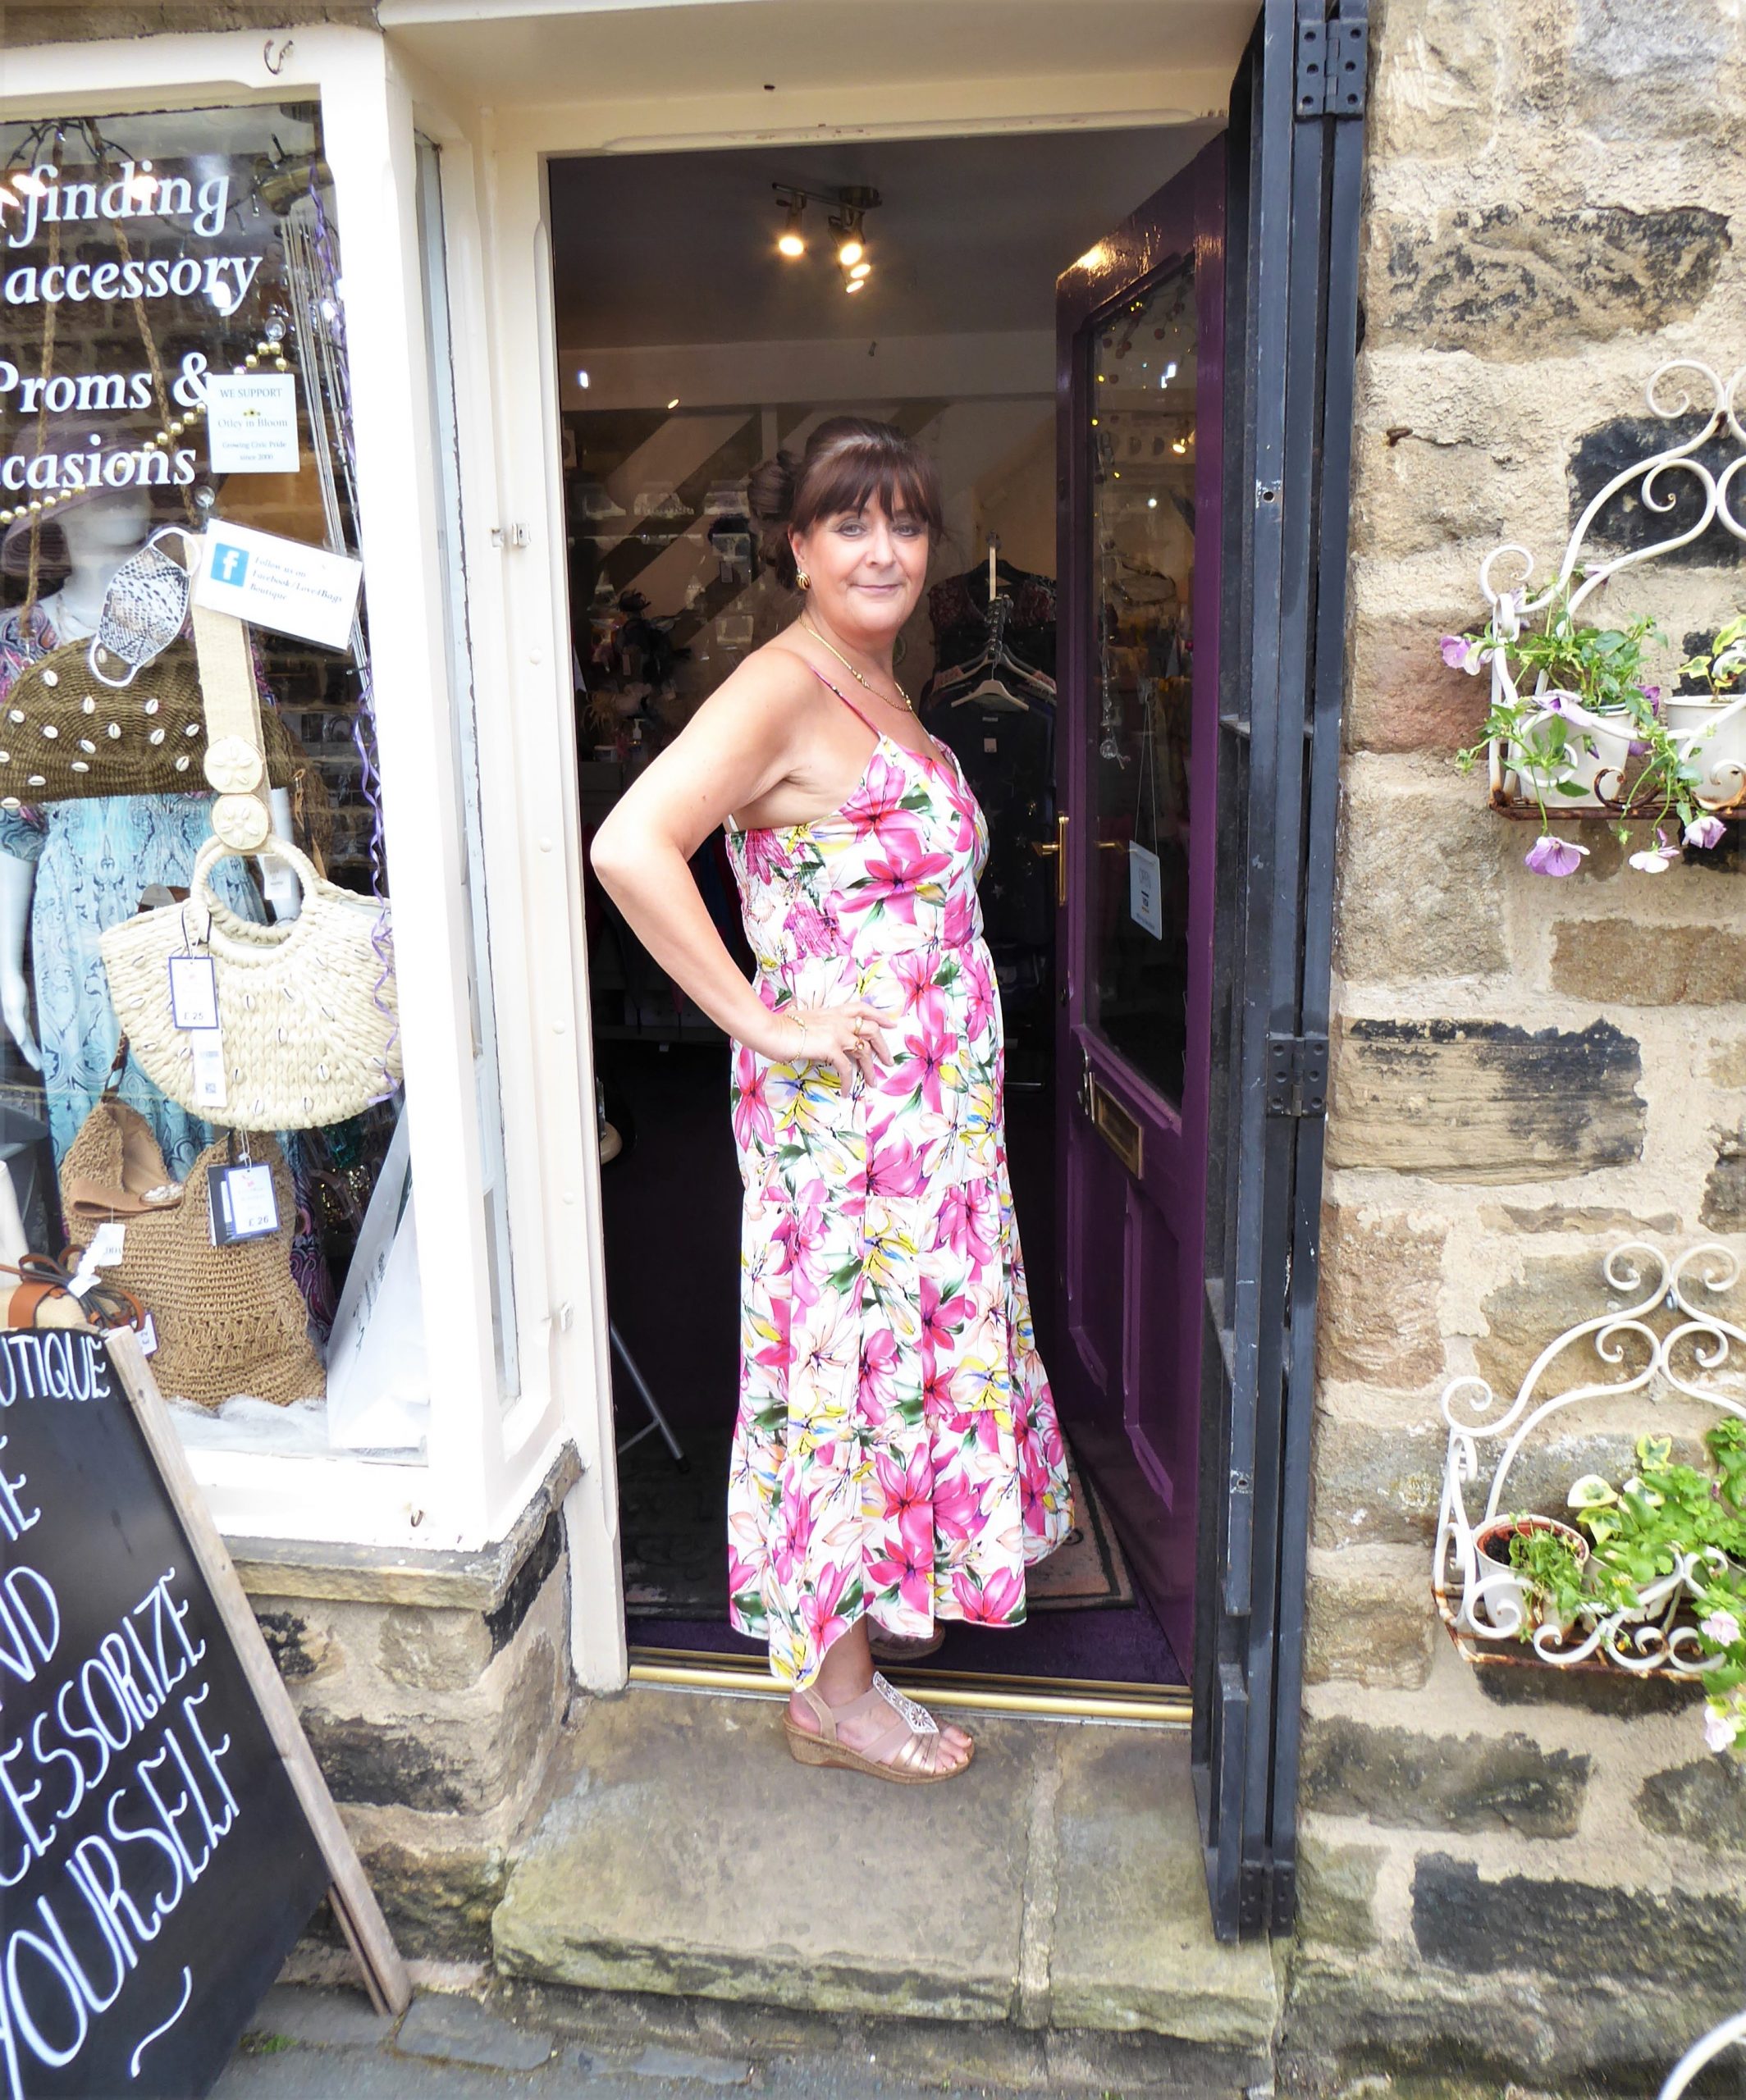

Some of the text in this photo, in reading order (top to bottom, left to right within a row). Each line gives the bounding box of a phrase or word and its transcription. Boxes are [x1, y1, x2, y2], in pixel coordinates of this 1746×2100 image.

[8, 160, 231, 248] finding
[5, 256, 263, 317] accessory
[172, 352, 212, 408] &
[220, 387, 283, 399] WE SUPPORT
[217, 418, 288, 430] Otley in Bloom
[0, 434, 196, 491] casions
[254, 556, 281, 569] Follow
[249, 582, 288, 600] Boutique
